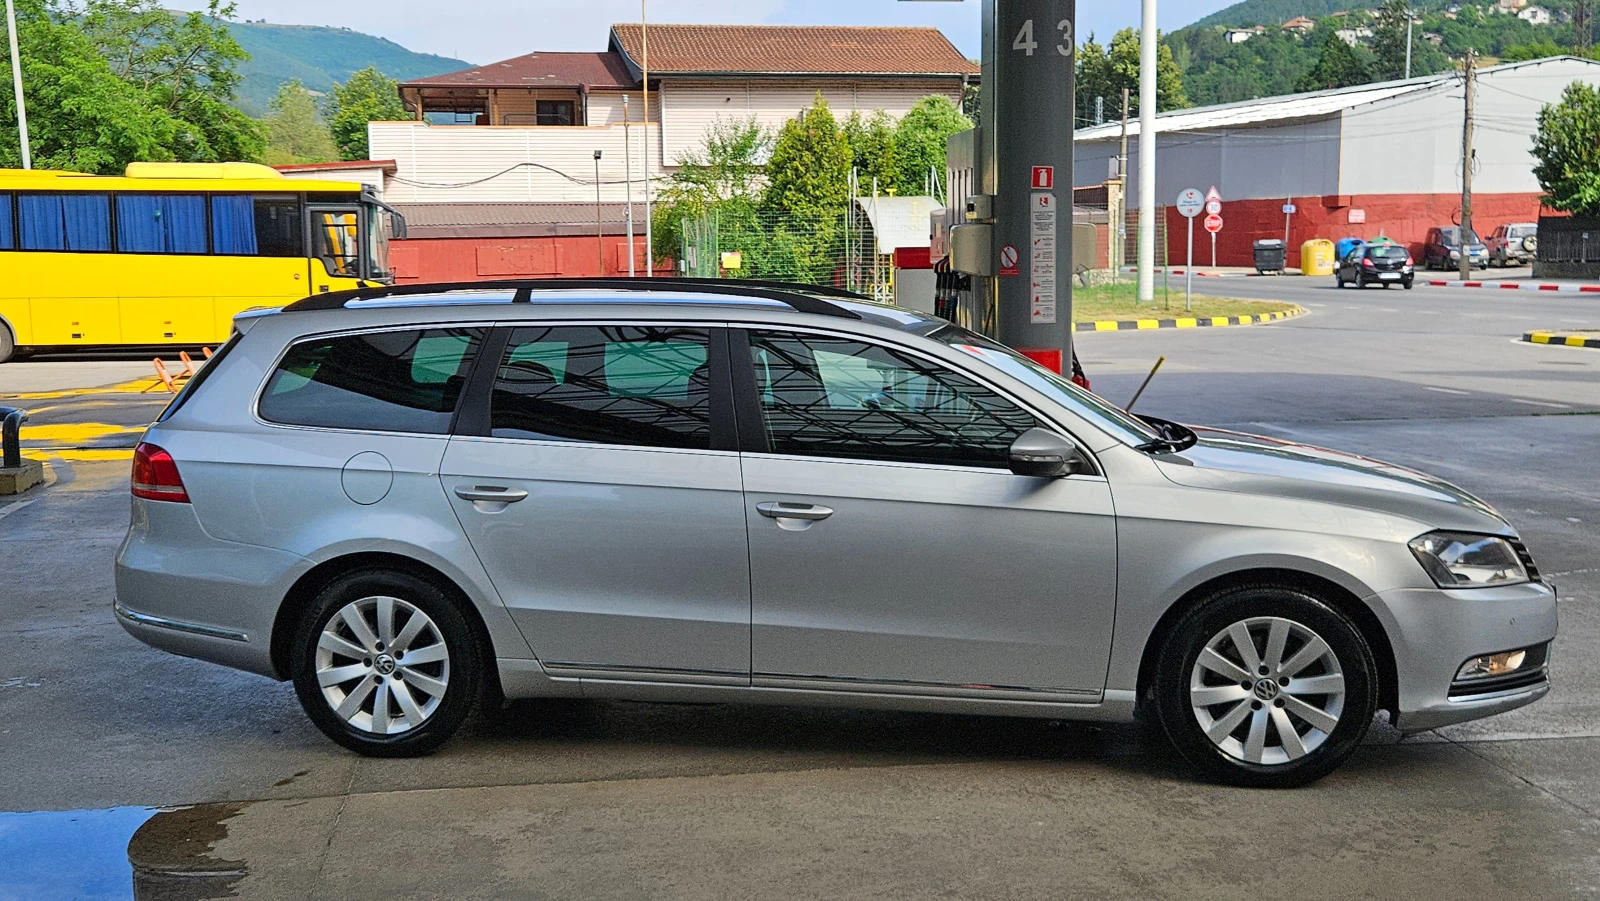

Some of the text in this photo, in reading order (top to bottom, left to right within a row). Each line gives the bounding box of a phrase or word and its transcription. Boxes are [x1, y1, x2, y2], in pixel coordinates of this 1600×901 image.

[1013, 19, 1073, 57] 4 3
[1255, 679, 1277, 699] VW
